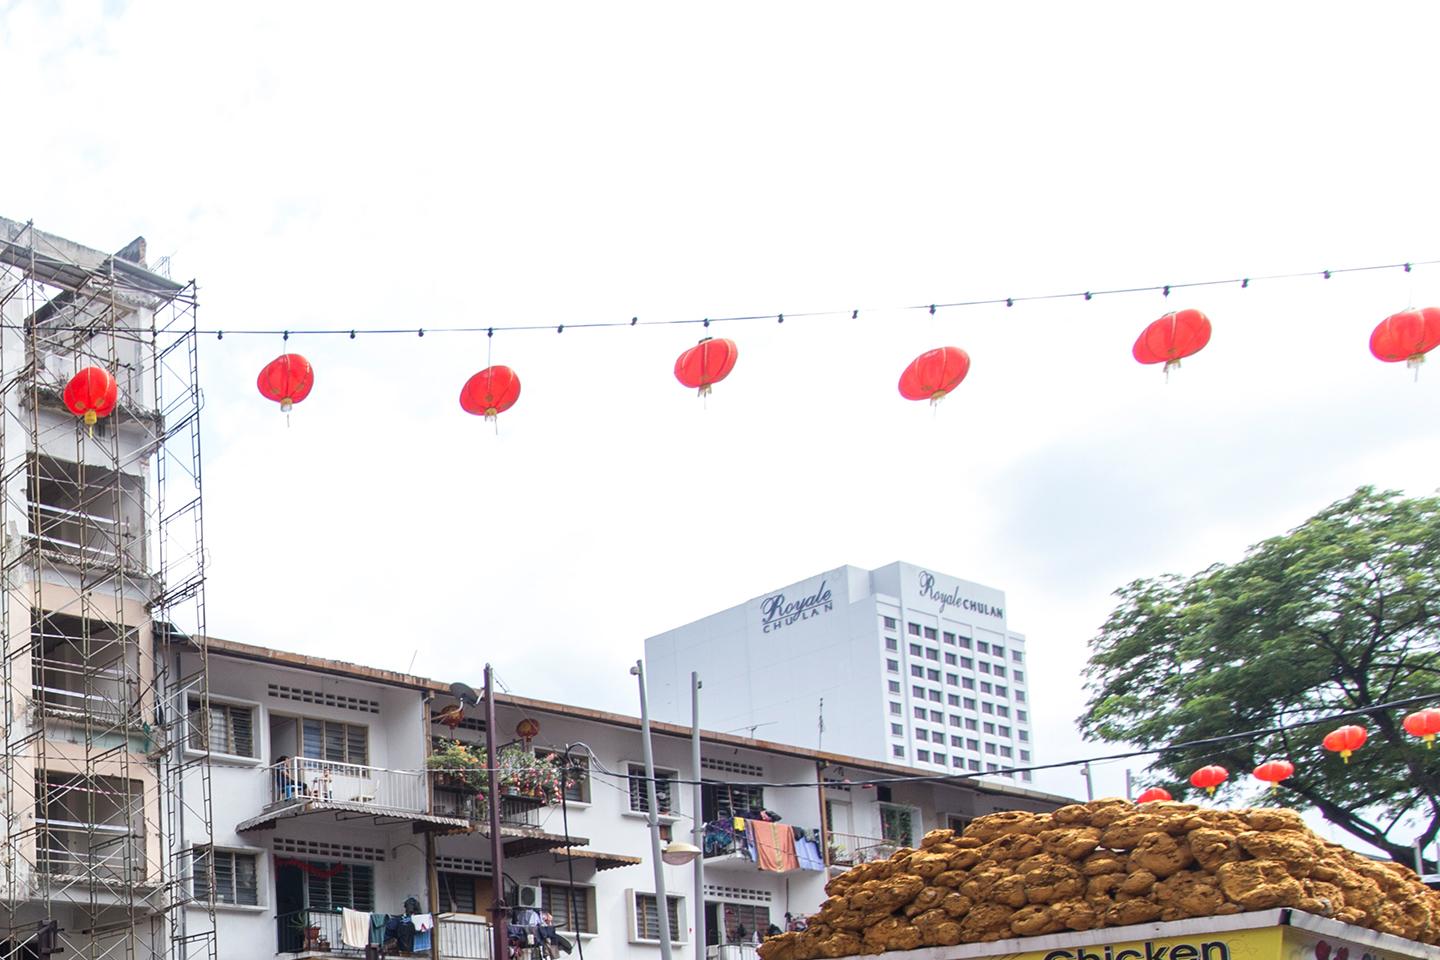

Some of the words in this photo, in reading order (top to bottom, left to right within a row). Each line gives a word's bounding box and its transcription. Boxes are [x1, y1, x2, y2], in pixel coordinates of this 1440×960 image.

[761, 580, 832, 623] Royale
[917, 569, 962, 614] Royale
[963, 597, 1003, 619] CHULAN
[762, 602, 833, 634] CHULAN
